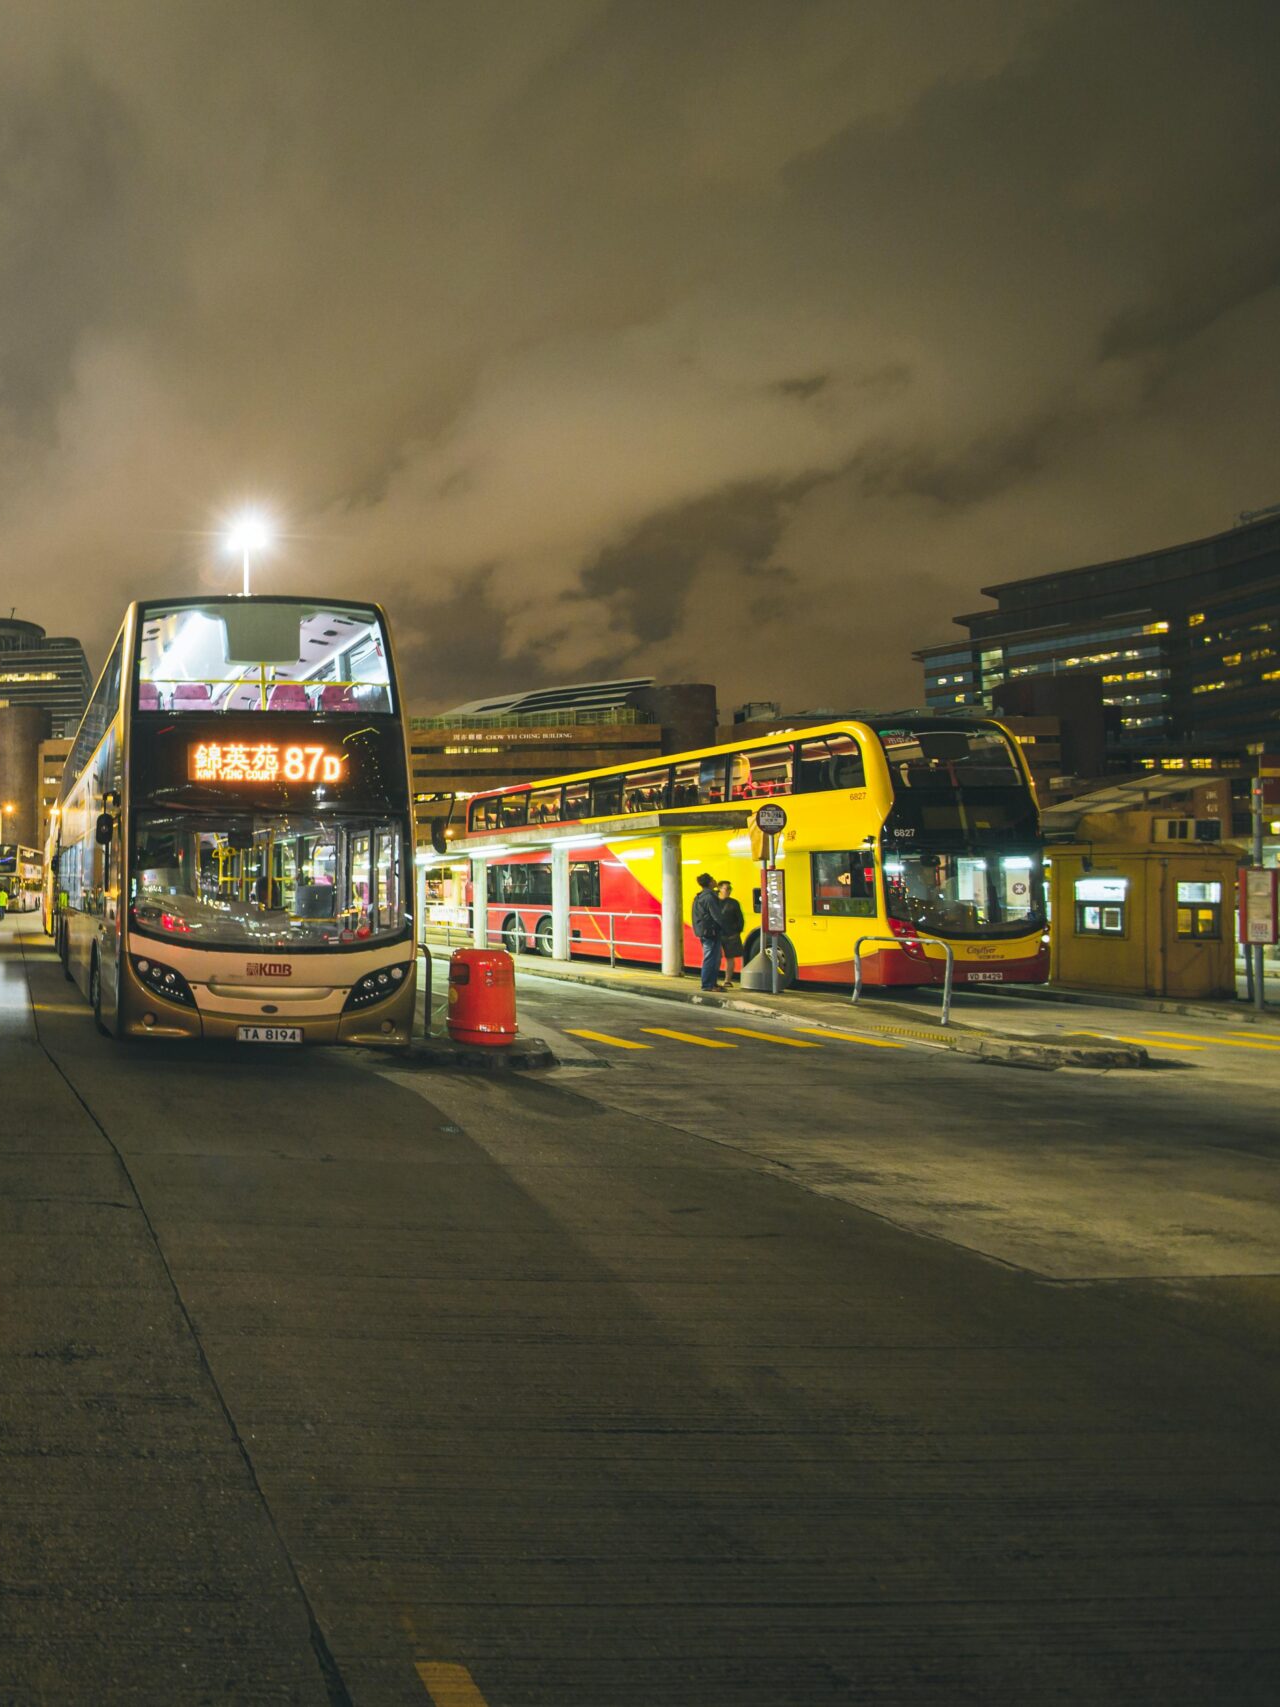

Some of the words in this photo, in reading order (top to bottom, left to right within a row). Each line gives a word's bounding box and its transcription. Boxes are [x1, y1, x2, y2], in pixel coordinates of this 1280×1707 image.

[195, 743, 278, 770] 錦英苑
[283, 747, 341, 781] 87D
[220, 770, 243, 780] YING
[245, 770, 277, 781] COURT
[850, 792, 867, 801] 6827
[894, 828, 915, 837] 6827
[260, 963, 292, 977] KMB
[243, 1028, 260, 1040] TA
[265, 1029, 297, 1041] 8194
